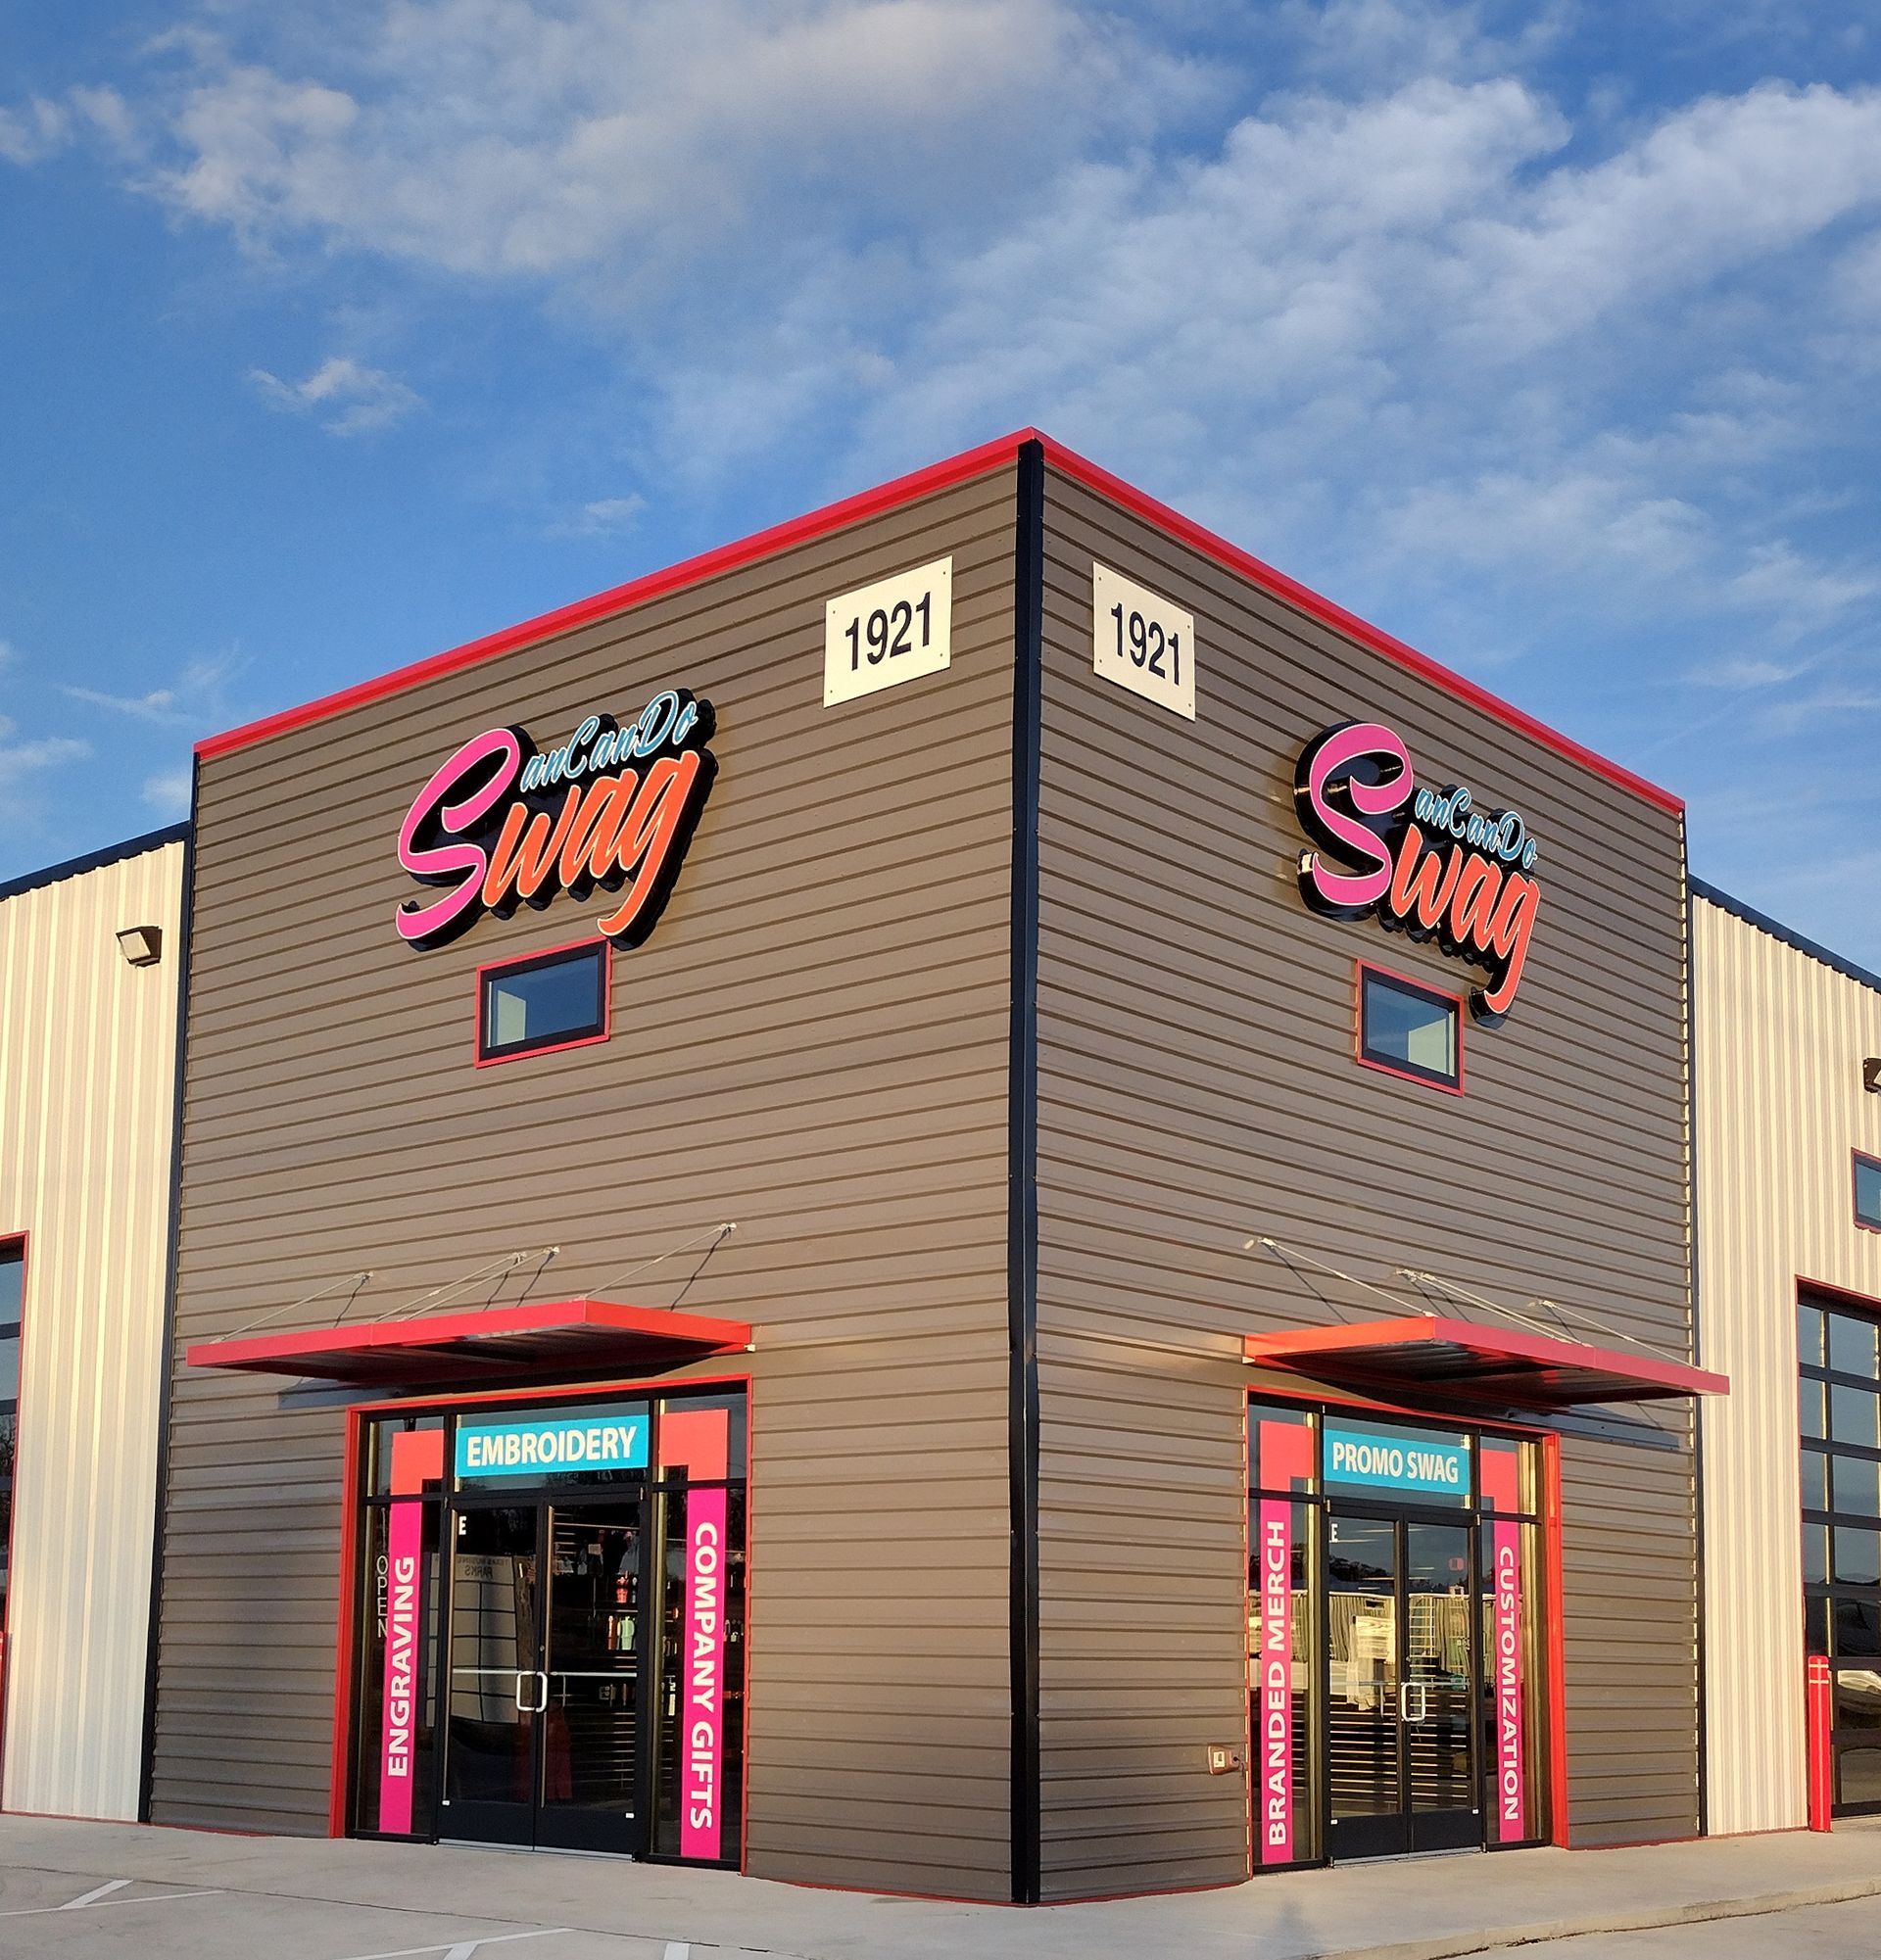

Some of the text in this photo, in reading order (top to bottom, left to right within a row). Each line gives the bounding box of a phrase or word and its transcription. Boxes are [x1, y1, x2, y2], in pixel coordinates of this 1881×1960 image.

[844, 592, 933, 671] 1921
[1110, 602, 1181, 687] 1921
[395, 727, 700, 939] Swag
[1309, 723, 1542, 1015] Swag
[466, 1425, 638, 1467] EMBROIDERY
[1332, 1441, 1459, 1484] PROMO SWAG
[458, 1515, 467, 1536] E
[1330, 1523, 1339, 1543] E
[376, 1554, 390, 1639] OPEN
[387, 1556, 414, 1778] ENGRAVING
[690, 1521, 718, 1830] COMPANY GIFTS
[1268, 1520, 1287, 1846] BRANDED MERCH
[1500, 1545, 1519, 1821] CUSTOMIZATION
